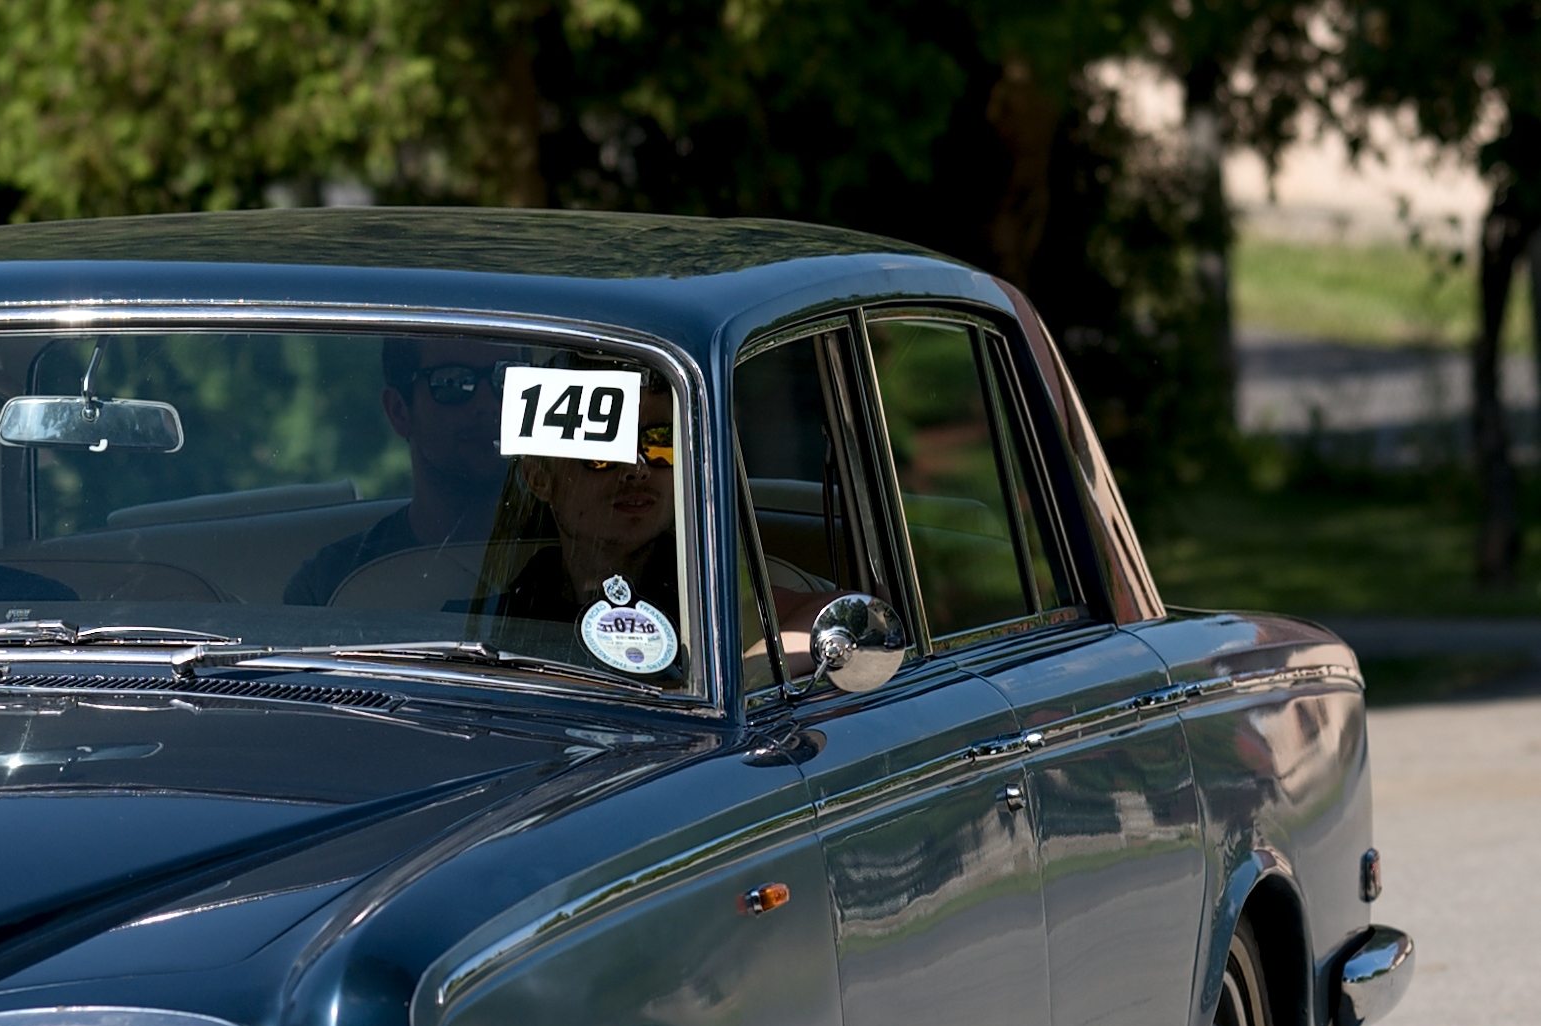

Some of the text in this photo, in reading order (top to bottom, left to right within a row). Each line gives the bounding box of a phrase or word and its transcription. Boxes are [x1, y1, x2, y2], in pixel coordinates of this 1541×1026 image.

[518, 383, 624, 442] 149
[614, 617, 636, 633] 07
[639, 623, 655, 634] 10
